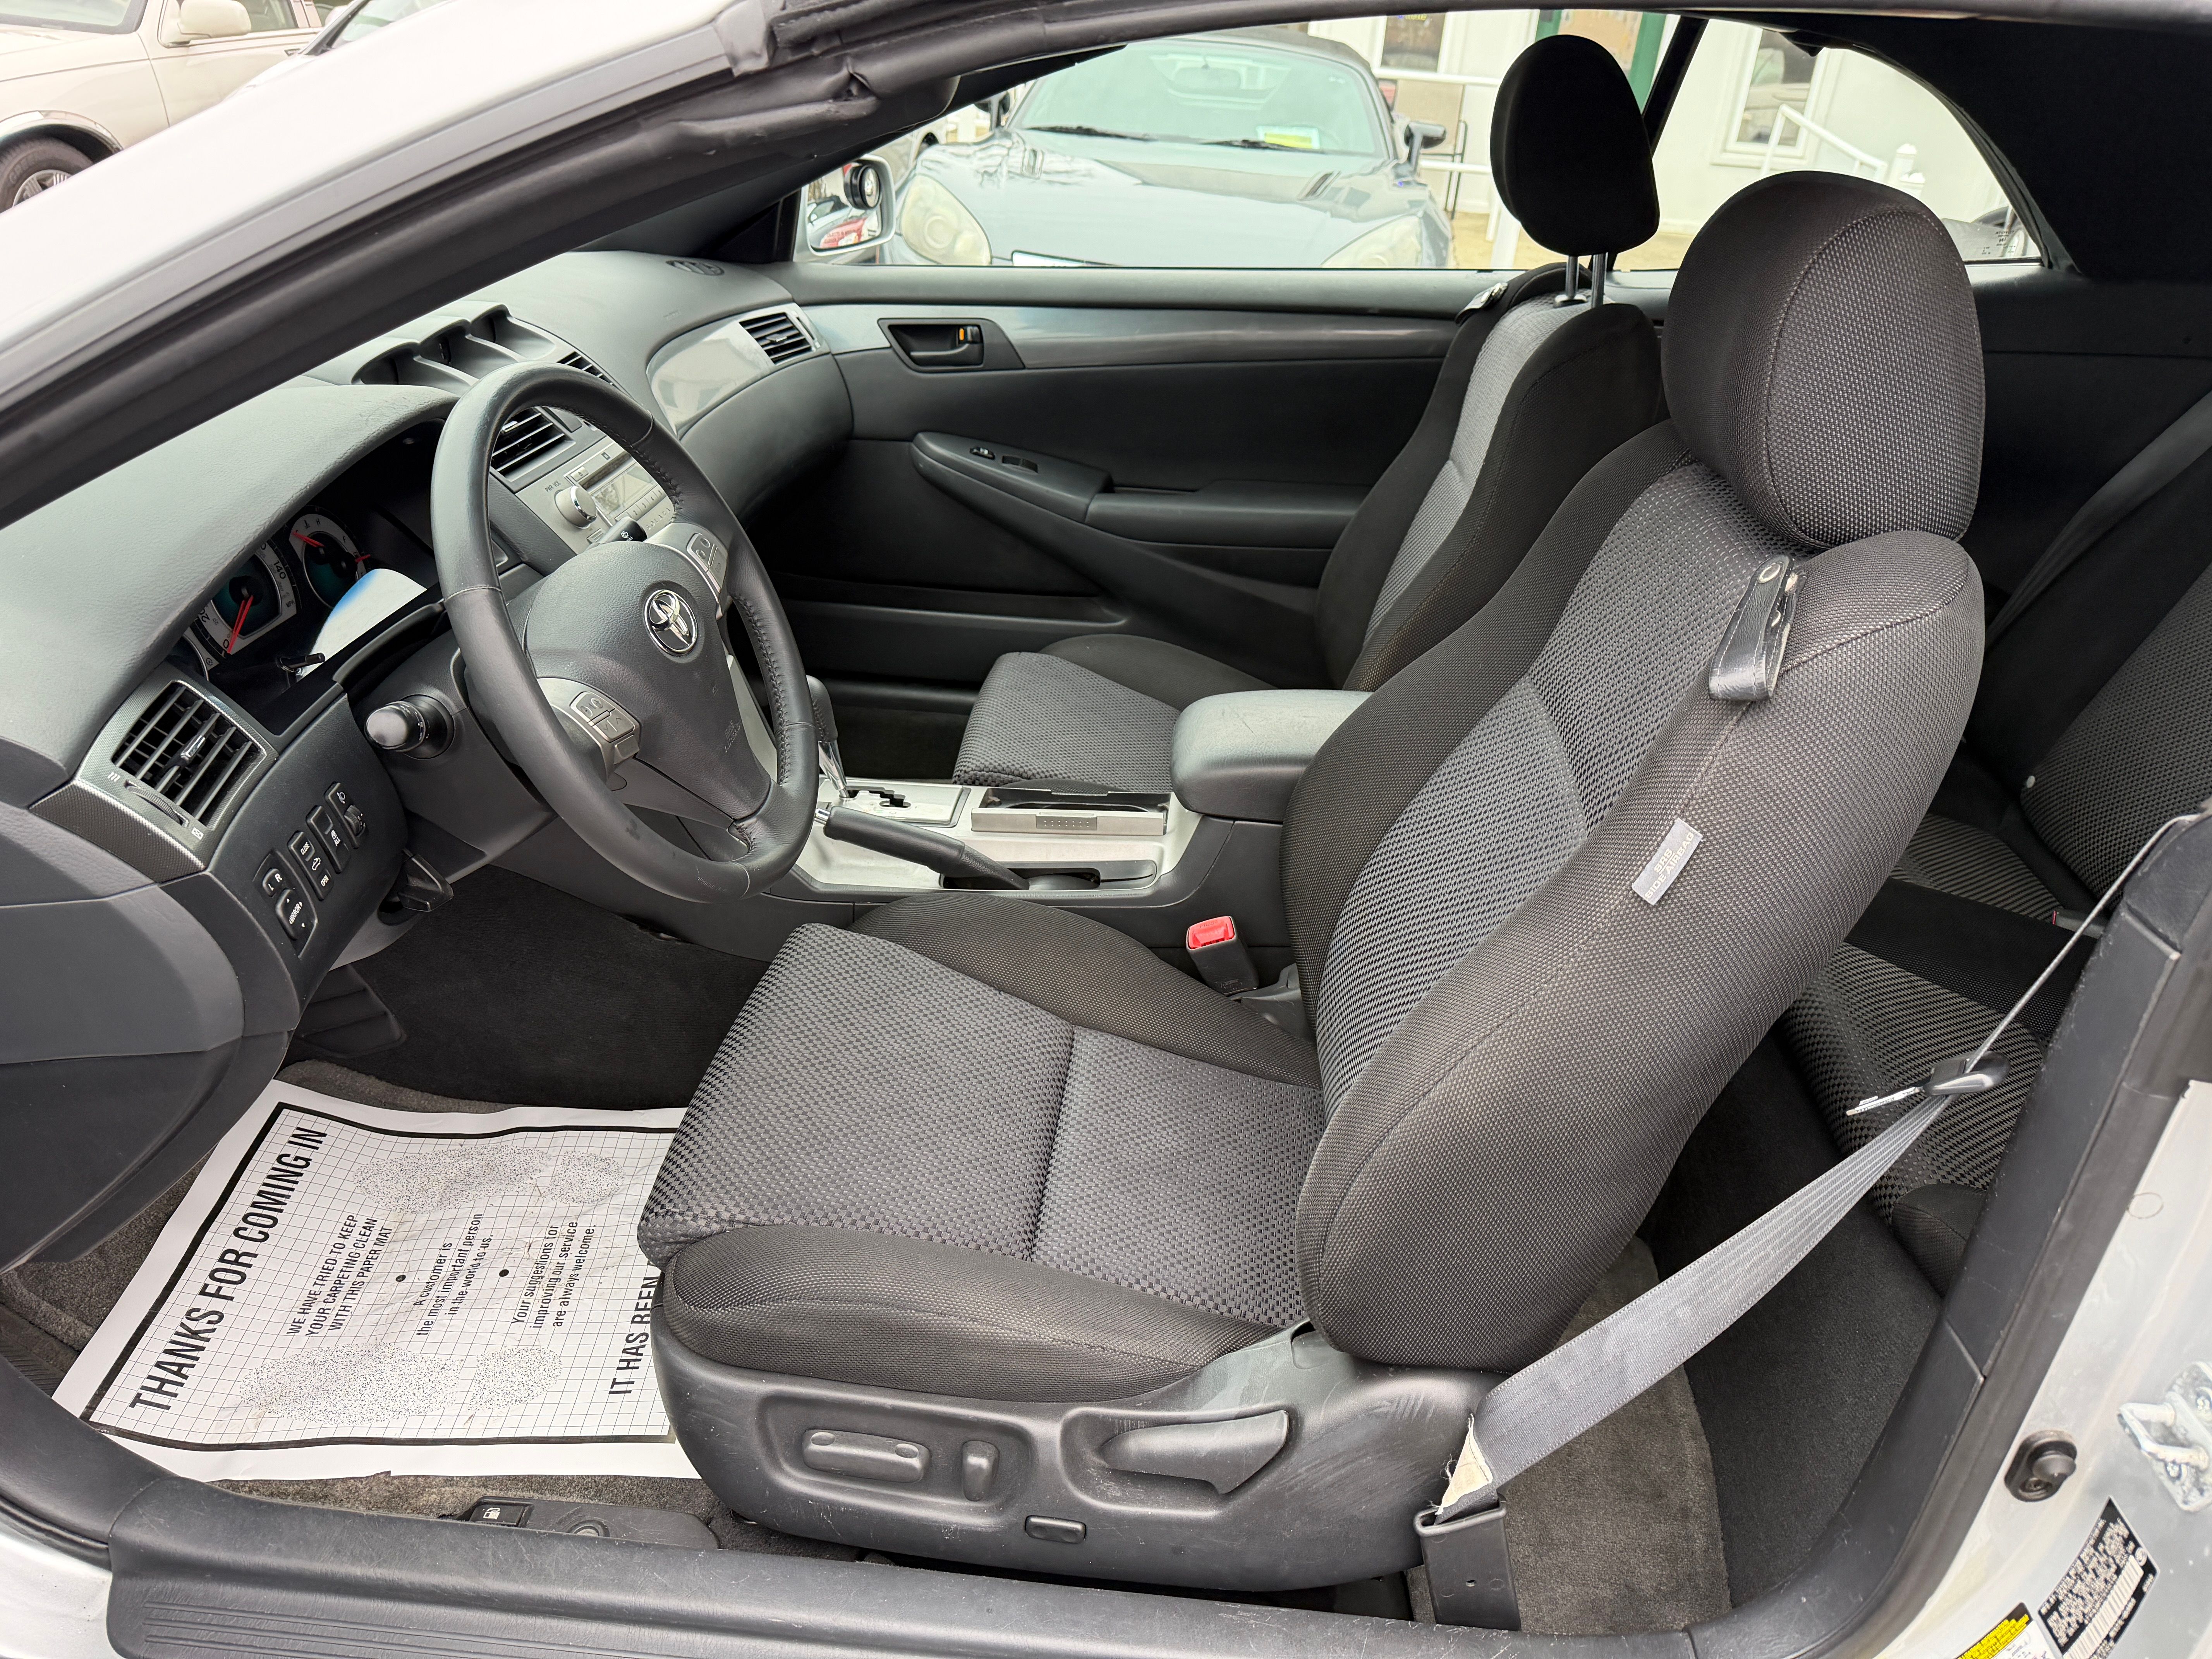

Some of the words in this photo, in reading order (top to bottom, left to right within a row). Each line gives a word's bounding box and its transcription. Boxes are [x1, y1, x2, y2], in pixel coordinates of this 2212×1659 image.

[646, 507, 671, 530] SOLARA
[273, 560, 286, 579] 140
[223, 639, 229, 649] 0
[300, 842, 310, 855] CLOSE
[1654, 848, 1673, 873] SRS
[275, 873, 282, 883] R
[1645, 873, 1667, 899] SIDE
[1666, 832, 1694, 875] AIRBAG
[320, 874, 329, 887] OPEN
[337, 1214, 358, 1239] KEEP
[329, 1242, 346, 1255] TO
[479, 1235, 494, 1249] us.
[558, 1221, 578, 1259] service
[572, 1224, 596, 1271] welcome.
[129, 1308, 224, 1410] THANKS
[198, 1249, 259, 1301] FOR
[233, 1154, 313, 1243] COMING
[287, 1127, 328, 1150] IN
[473, 1252, 486, 1261] to
[552, 1261, 566, 1276] our
[305, 1307, 332, 1336] YOUR
[323, 1251, 361, 1304] CARPETING
[353, 1218, 378, 1249] CLEAN
[312, 1258, 338, 1287] TRIED
[328, 1305, 352, 1331] WITH
[343, 1280, 365, 1302] THIS
[356, 1249, 382, 1278] PAPER
[373, 1226, 393, 1247] MAT
[416, 1321, 434, 1336] the
[427, 1295, 447, 1317] most
[437, 1249, 469, 1293] important
[462, 1214, 483, 1246] person
[420, 1254, 448, 1298] customer
[438, 1242, 453, 1250] is
[461, 1263, 481, 1288] world
[511, 1300, 531, 1324] Your
[524, 1242, 554, 1297] suggestions
[544, 1225, 559, 1240] for
[297, 1290, 322, 1315] HAVE
[451, 1290, 468, 1304] the
[529, 1277, 562, 1328] improving
[558, 1273, 580, 1307] always
[630, 1277, 659, 1324] BEEN
[445, 1307, 460, 1315] in
[552, 1310, 567, 1327] are
[286, 1317, 306, 1334] WE
[616, 1332, 649, 1370] HAS
[608, 1377, 635, 1395] IT
